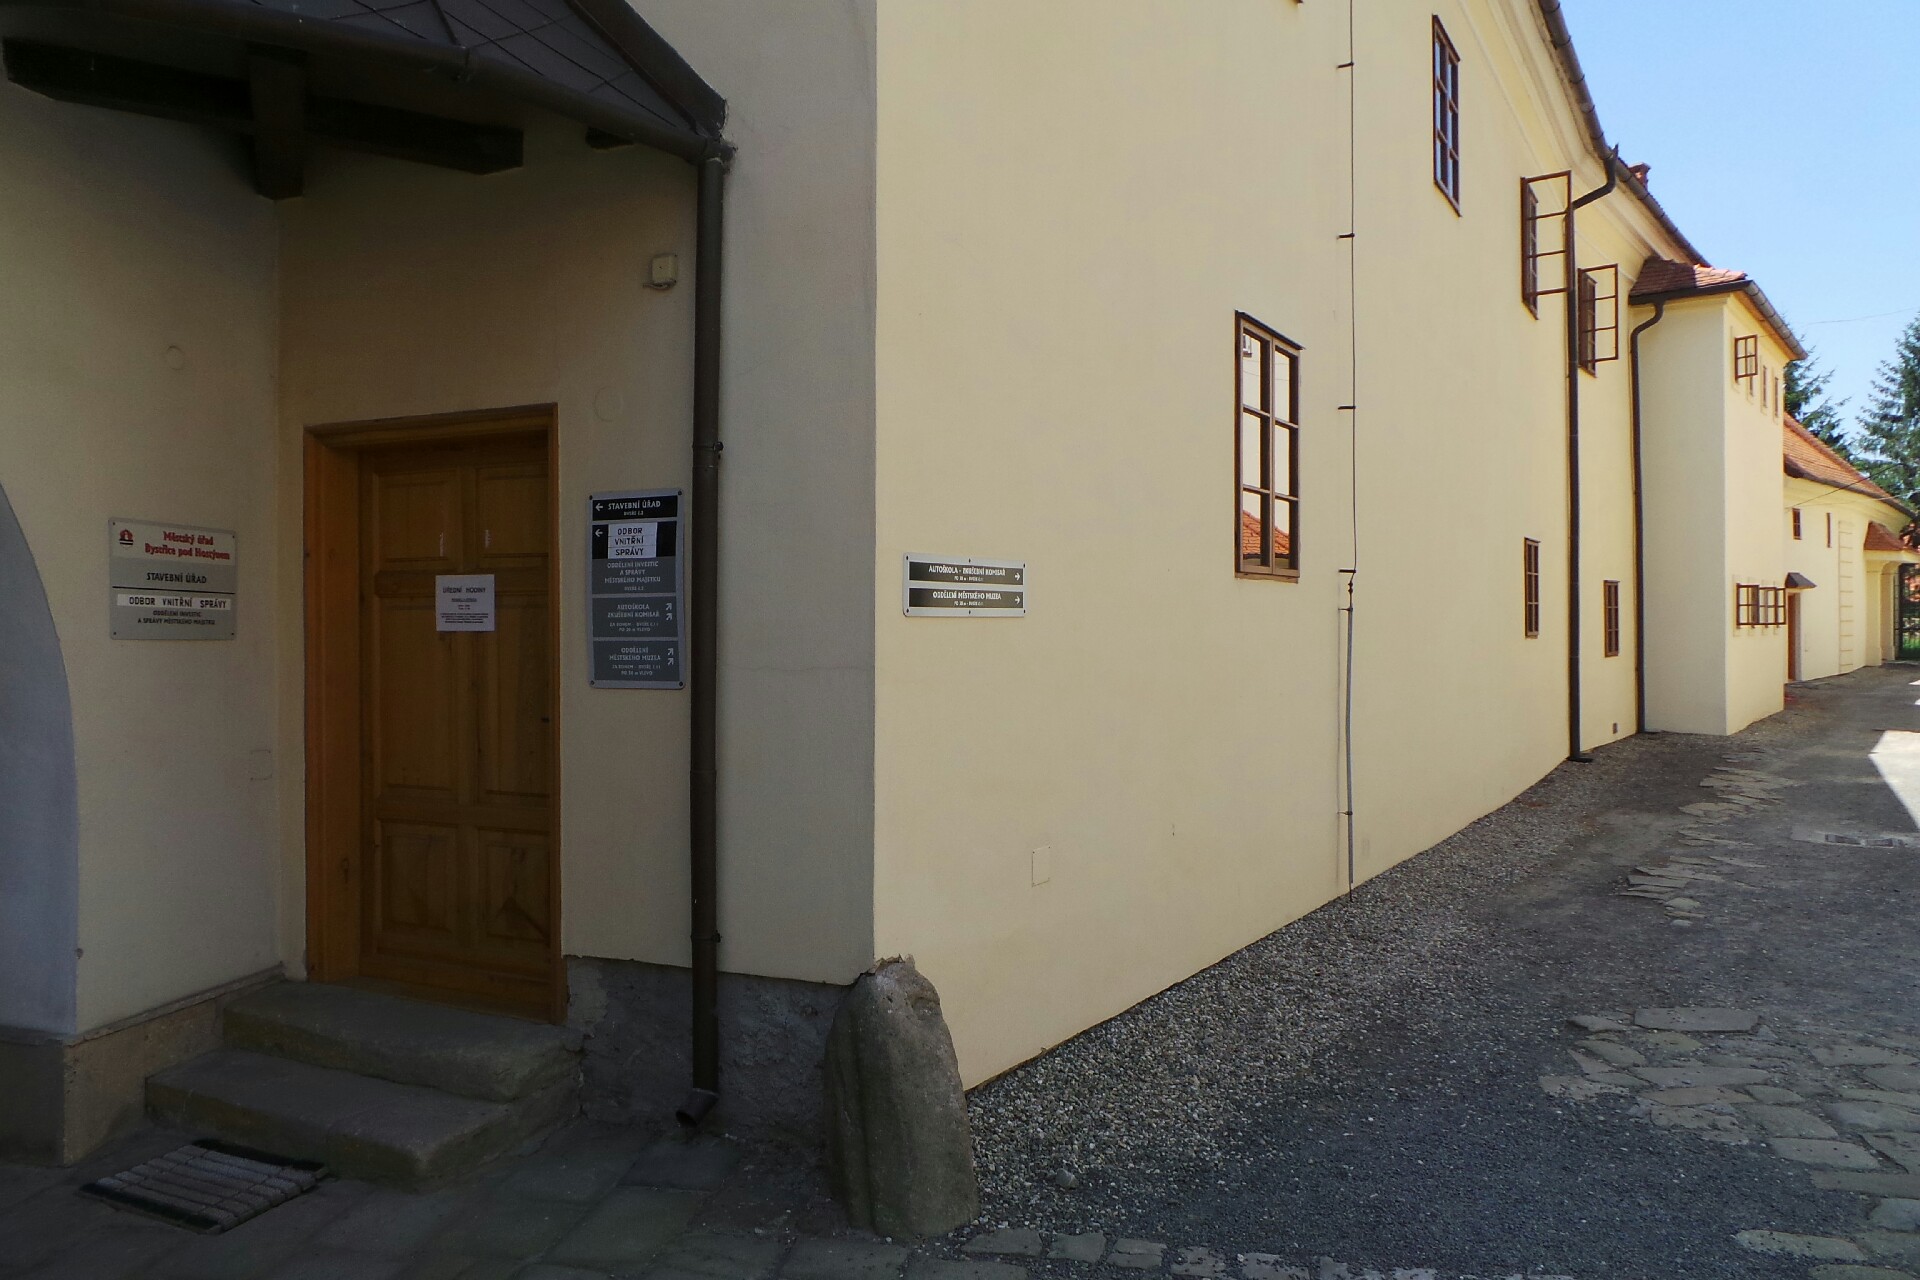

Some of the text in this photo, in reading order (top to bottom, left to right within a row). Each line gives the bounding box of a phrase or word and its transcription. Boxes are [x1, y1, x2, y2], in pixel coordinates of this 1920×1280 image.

[608, 499, 661, 510] STAVEBNÍ ÚŘAD
[617, 527, 643, 536] ODBOR
[163, 531, 214, 546] Městský úřad
[614, 536, 644, 546] VNITŘNÍ
[144, 542, 230, 560] Bystřice pod Hostýnem
[615, 547, 644, 556] SPRÁVY
[607, 560, 659, 569] ODDĚLENÍ INVESTIC
[928, 564, 959, 574] AUTOŠKOLA
[962, 567, 985, 576] ZKUŠEBNÍ
[985, 568, 1006, 577] KOMISAŘ
[146, 572, 207, 584] STAVEBNÍ ÚŘAD
[636, 576, 661, 584] MAJETKU
[932, 589, 1002, 600] ODDĚLENÍ MĚSTSKÉHO MUZEA
[129, 596, 227, 609] ODBOR VNITŘNÍ SPRÁVY
[620, 646, 649, 654] ODDĚLENÍ
[609, 653, 640, 661] MĚSTSKÉHO
